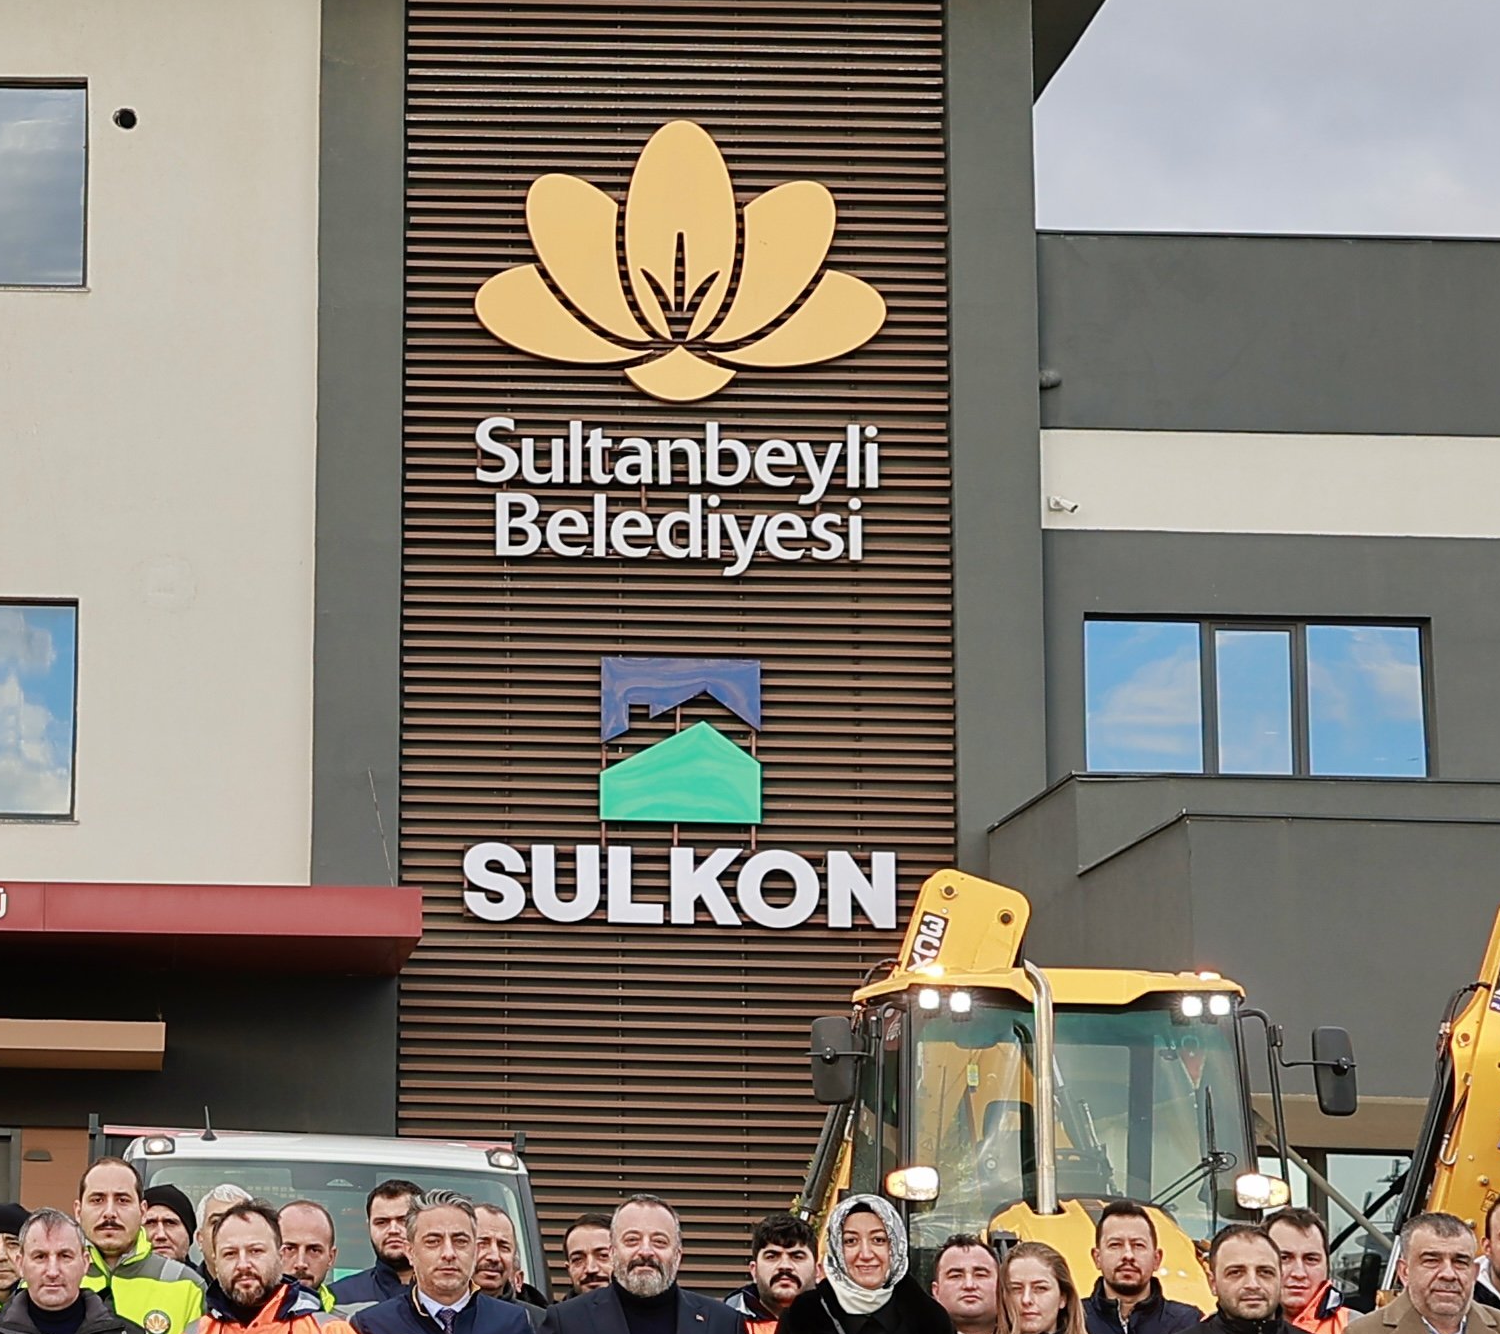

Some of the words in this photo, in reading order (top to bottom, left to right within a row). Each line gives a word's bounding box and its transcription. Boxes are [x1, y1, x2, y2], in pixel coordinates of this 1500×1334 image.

[474, 416, 880, 505] Sultanbeyli
[494, 494, 863, 578] Belediyesi
[462, 841, 898, 930] SULKON
